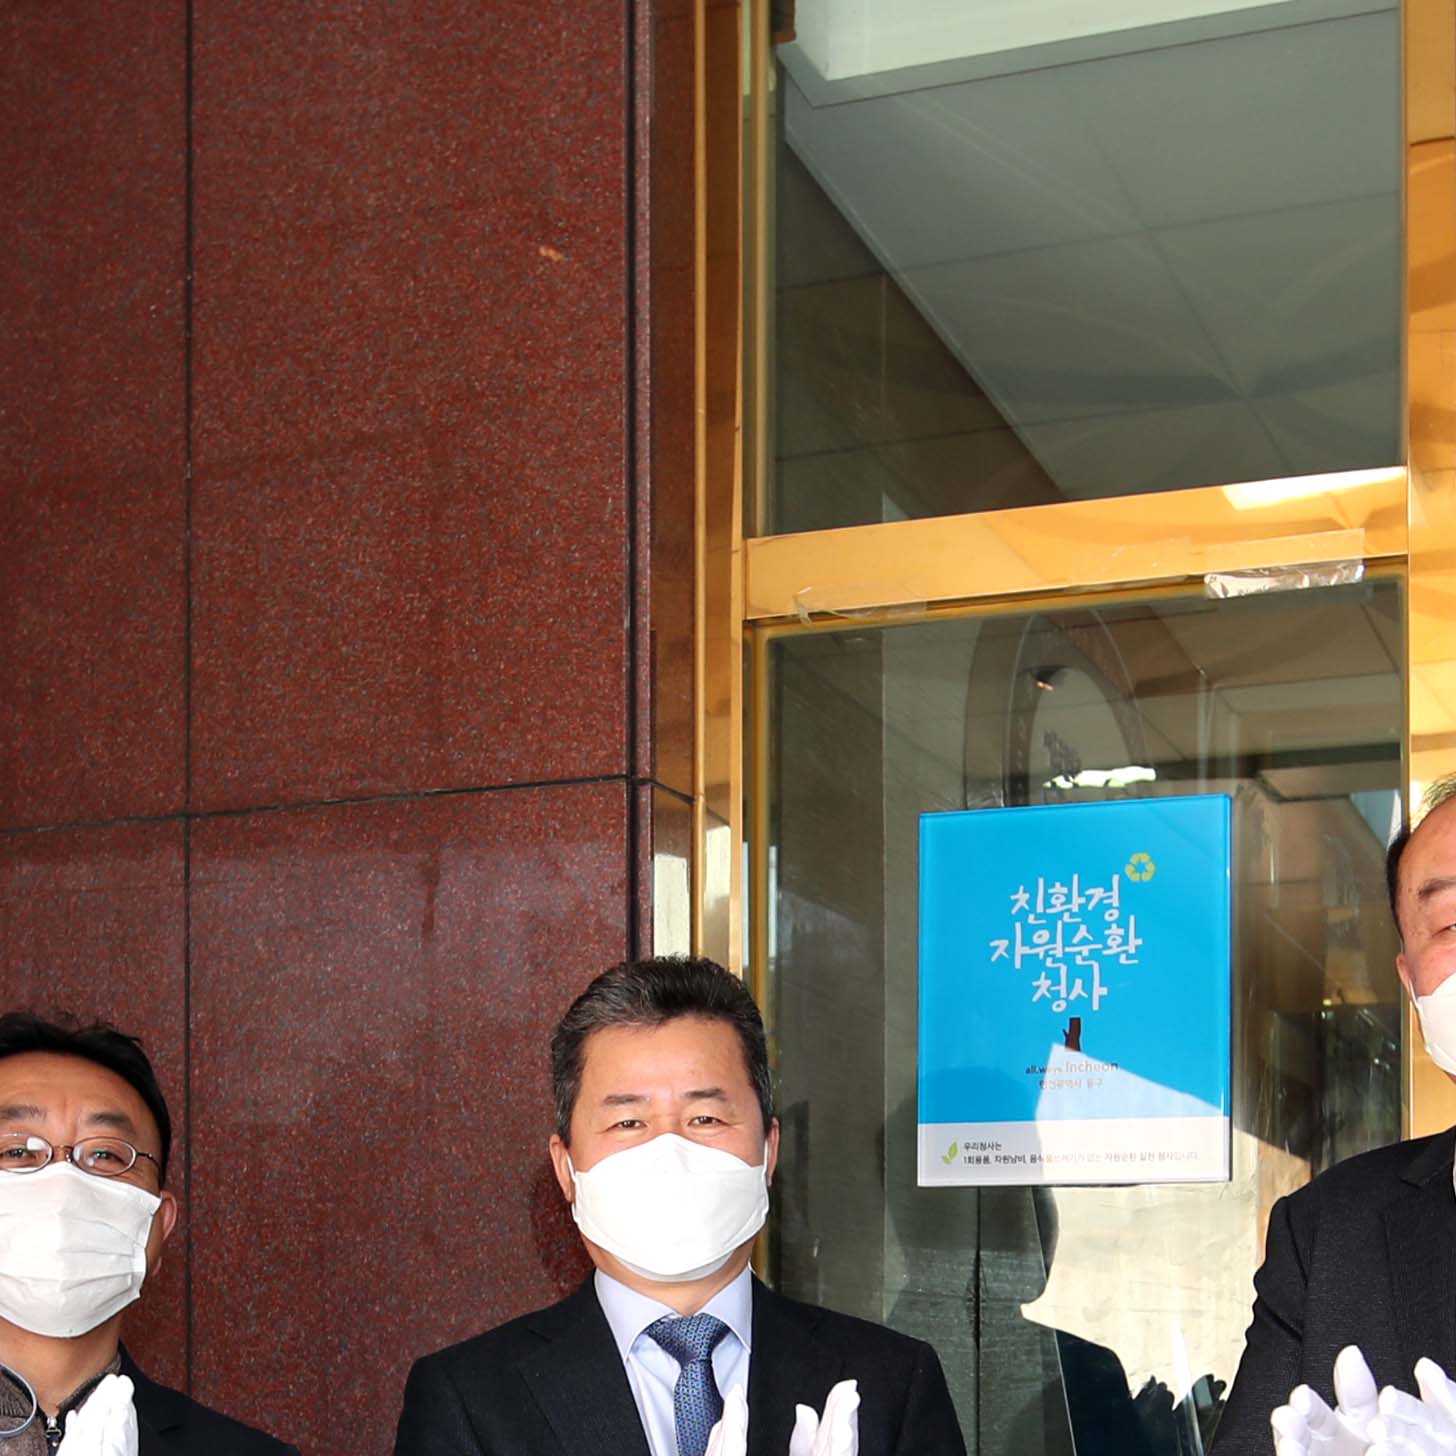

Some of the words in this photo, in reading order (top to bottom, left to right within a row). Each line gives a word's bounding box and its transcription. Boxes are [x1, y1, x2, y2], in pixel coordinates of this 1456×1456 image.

[1010, 874, 1120, 924] 친환경
[989, 915, 1143, 969] 자원순환
[1031, 961, 1108, 1013] 청사
